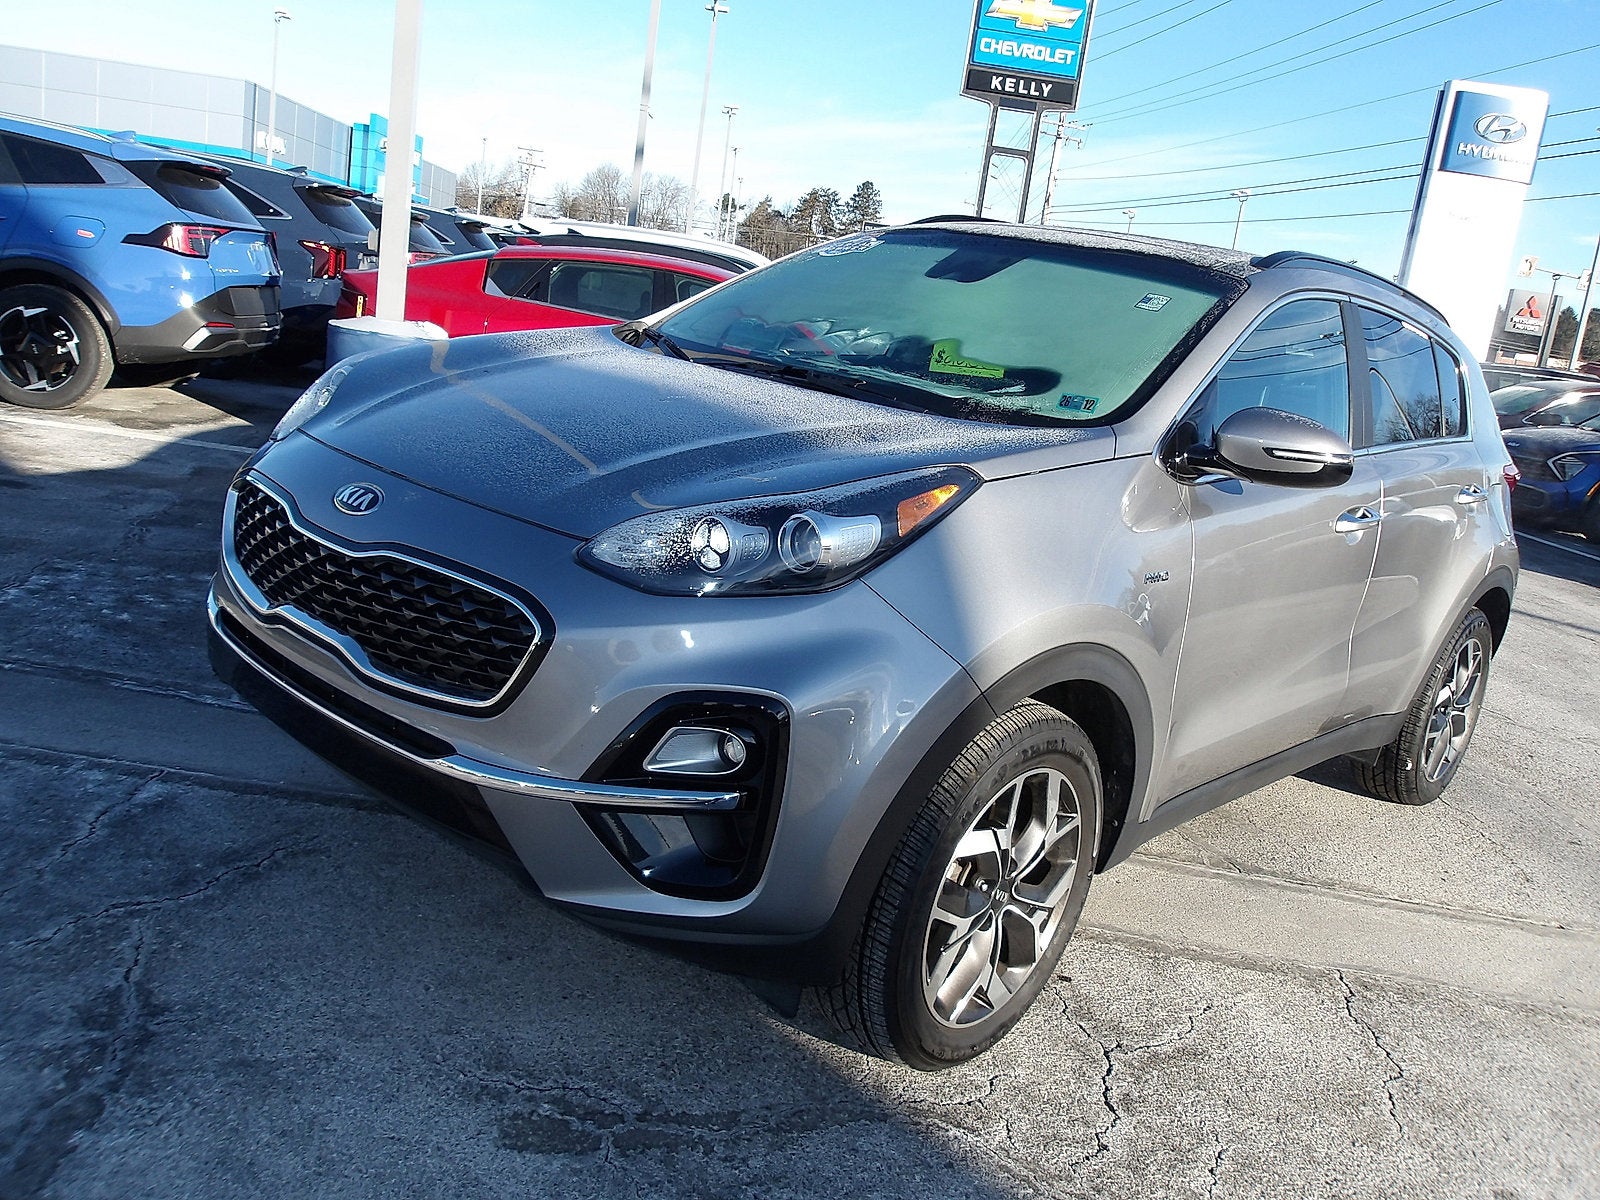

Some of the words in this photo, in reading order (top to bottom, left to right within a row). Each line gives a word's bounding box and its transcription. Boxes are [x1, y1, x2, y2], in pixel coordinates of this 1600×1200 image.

[979, 37, 1076, 65] CHEVROLET
[990, 75, 1053, 97] KELLY
[1457, 141, 1530, 166] HYUN
[1082, 398, 1096, 411] 12
[337, 485, 375, 511] KIA
